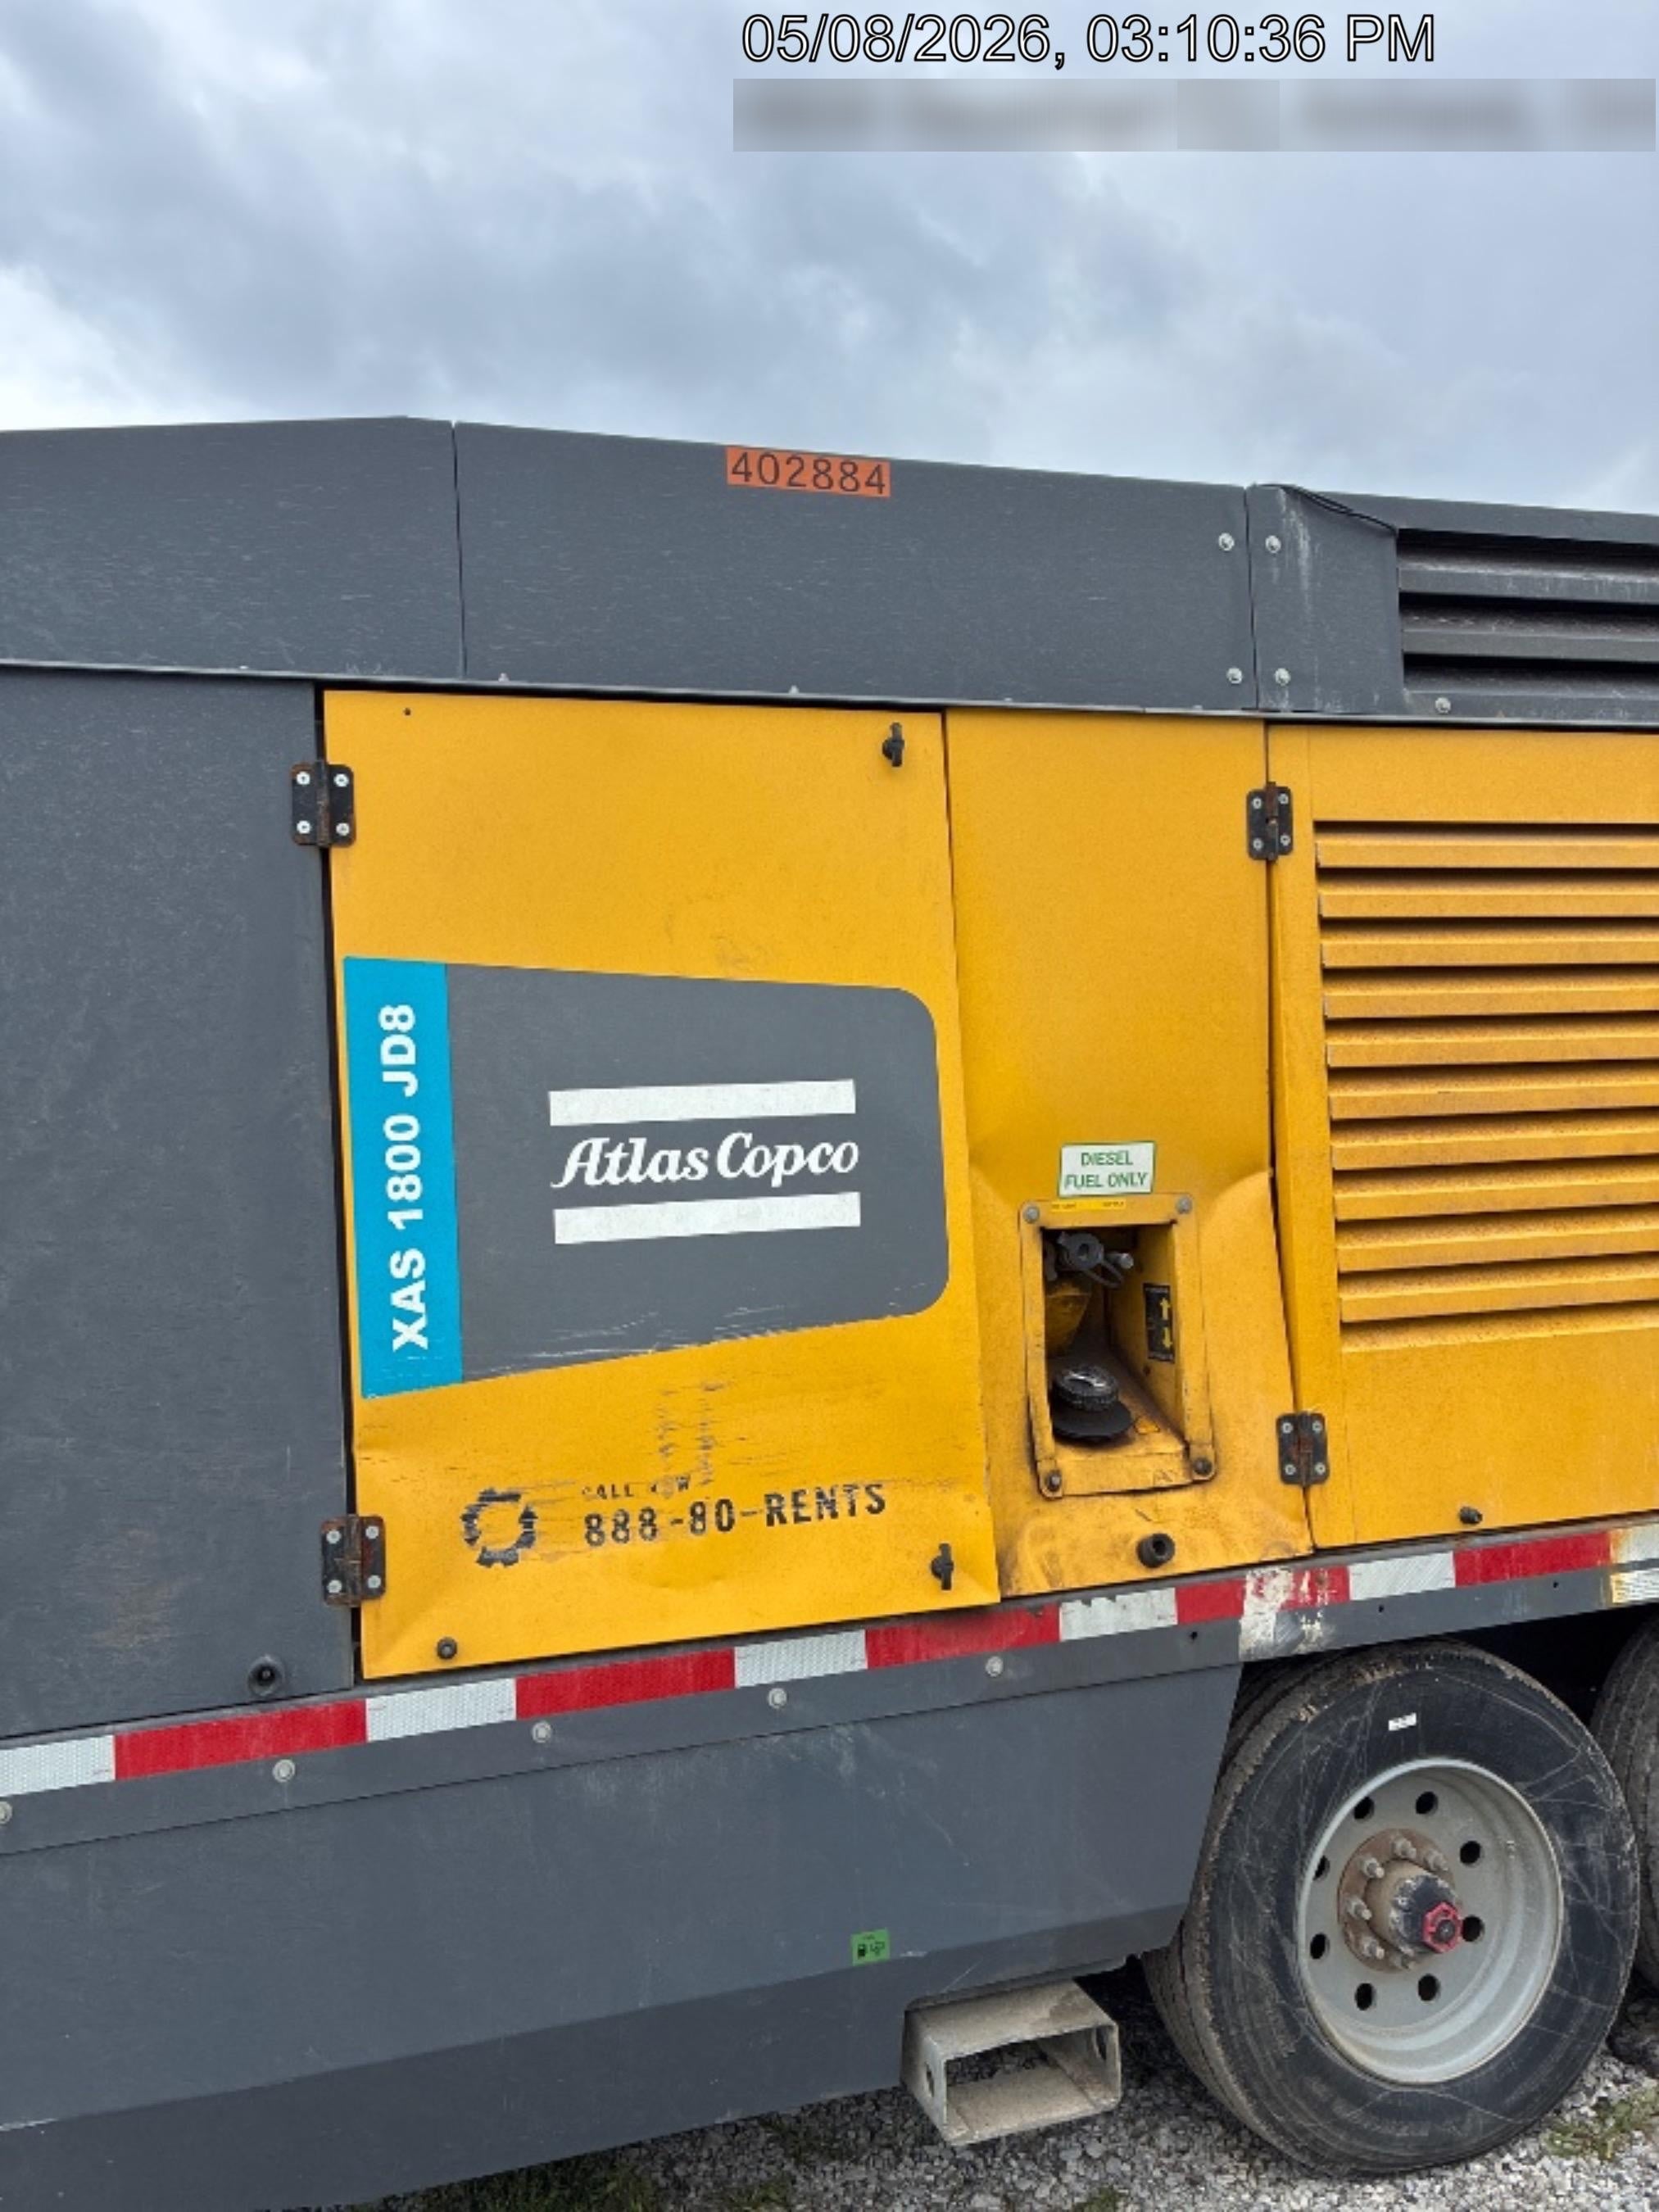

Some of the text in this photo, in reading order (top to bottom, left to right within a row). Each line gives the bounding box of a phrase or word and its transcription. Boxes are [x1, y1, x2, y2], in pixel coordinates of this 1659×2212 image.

[731, 451, 886, 495] 402884
[379, 1004, 428, 1352] XAS 1800 JD8
[550, 1131, 859, 1189] Atlas Copco
[1065, 1172, 1147, 1189] FUEL ONLY
[1081, 1150, 1133, 1167] DIESEL
